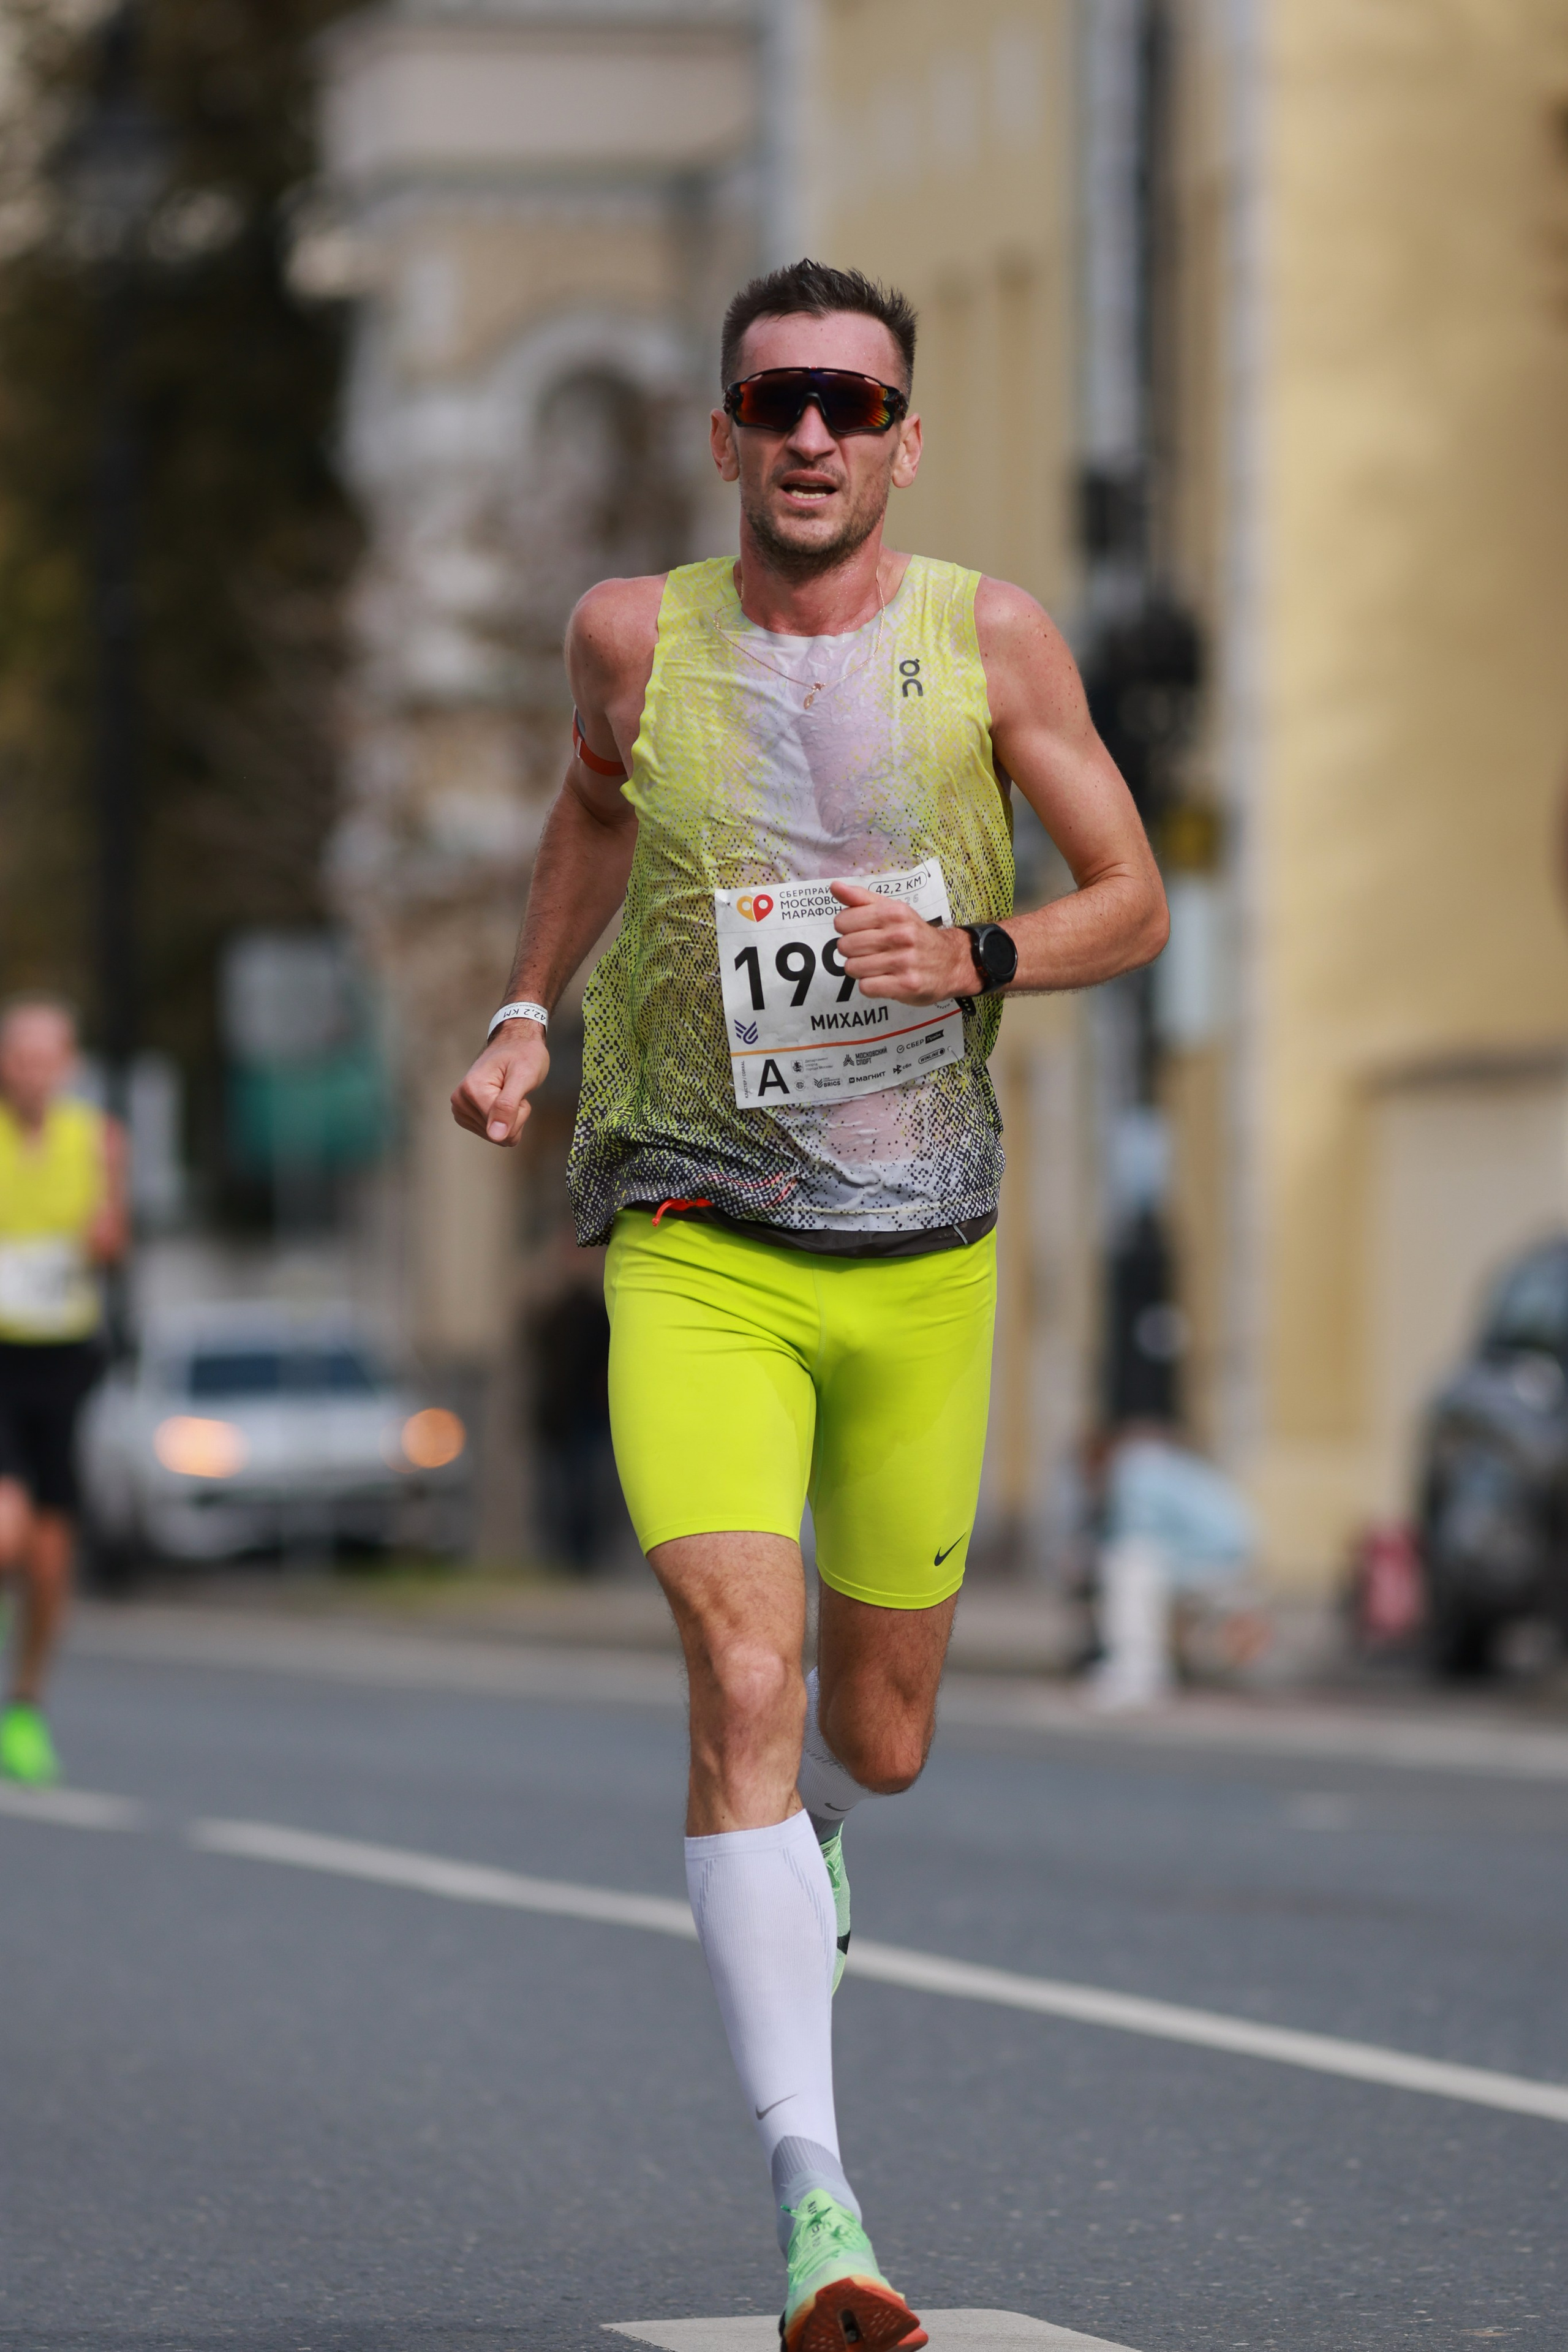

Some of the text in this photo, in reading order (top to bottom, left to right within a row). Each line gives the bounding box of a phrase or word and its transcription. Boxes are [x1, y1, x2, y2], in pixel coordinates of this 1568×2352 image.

[779, 885, 831, 899] СБЕРПРАЙ
[876, 883, 901, 894] 42,2
[780, 896, 839, 910] МОСКОВС
[524, 1008, 546, 1020] 42,2
[810, 1006, 889, 1031] МИХАИЛ
[906, 1039, 924, 1050] СБЕР
[855, 1046, 888, 1059] МОСКОВСКИЙ
